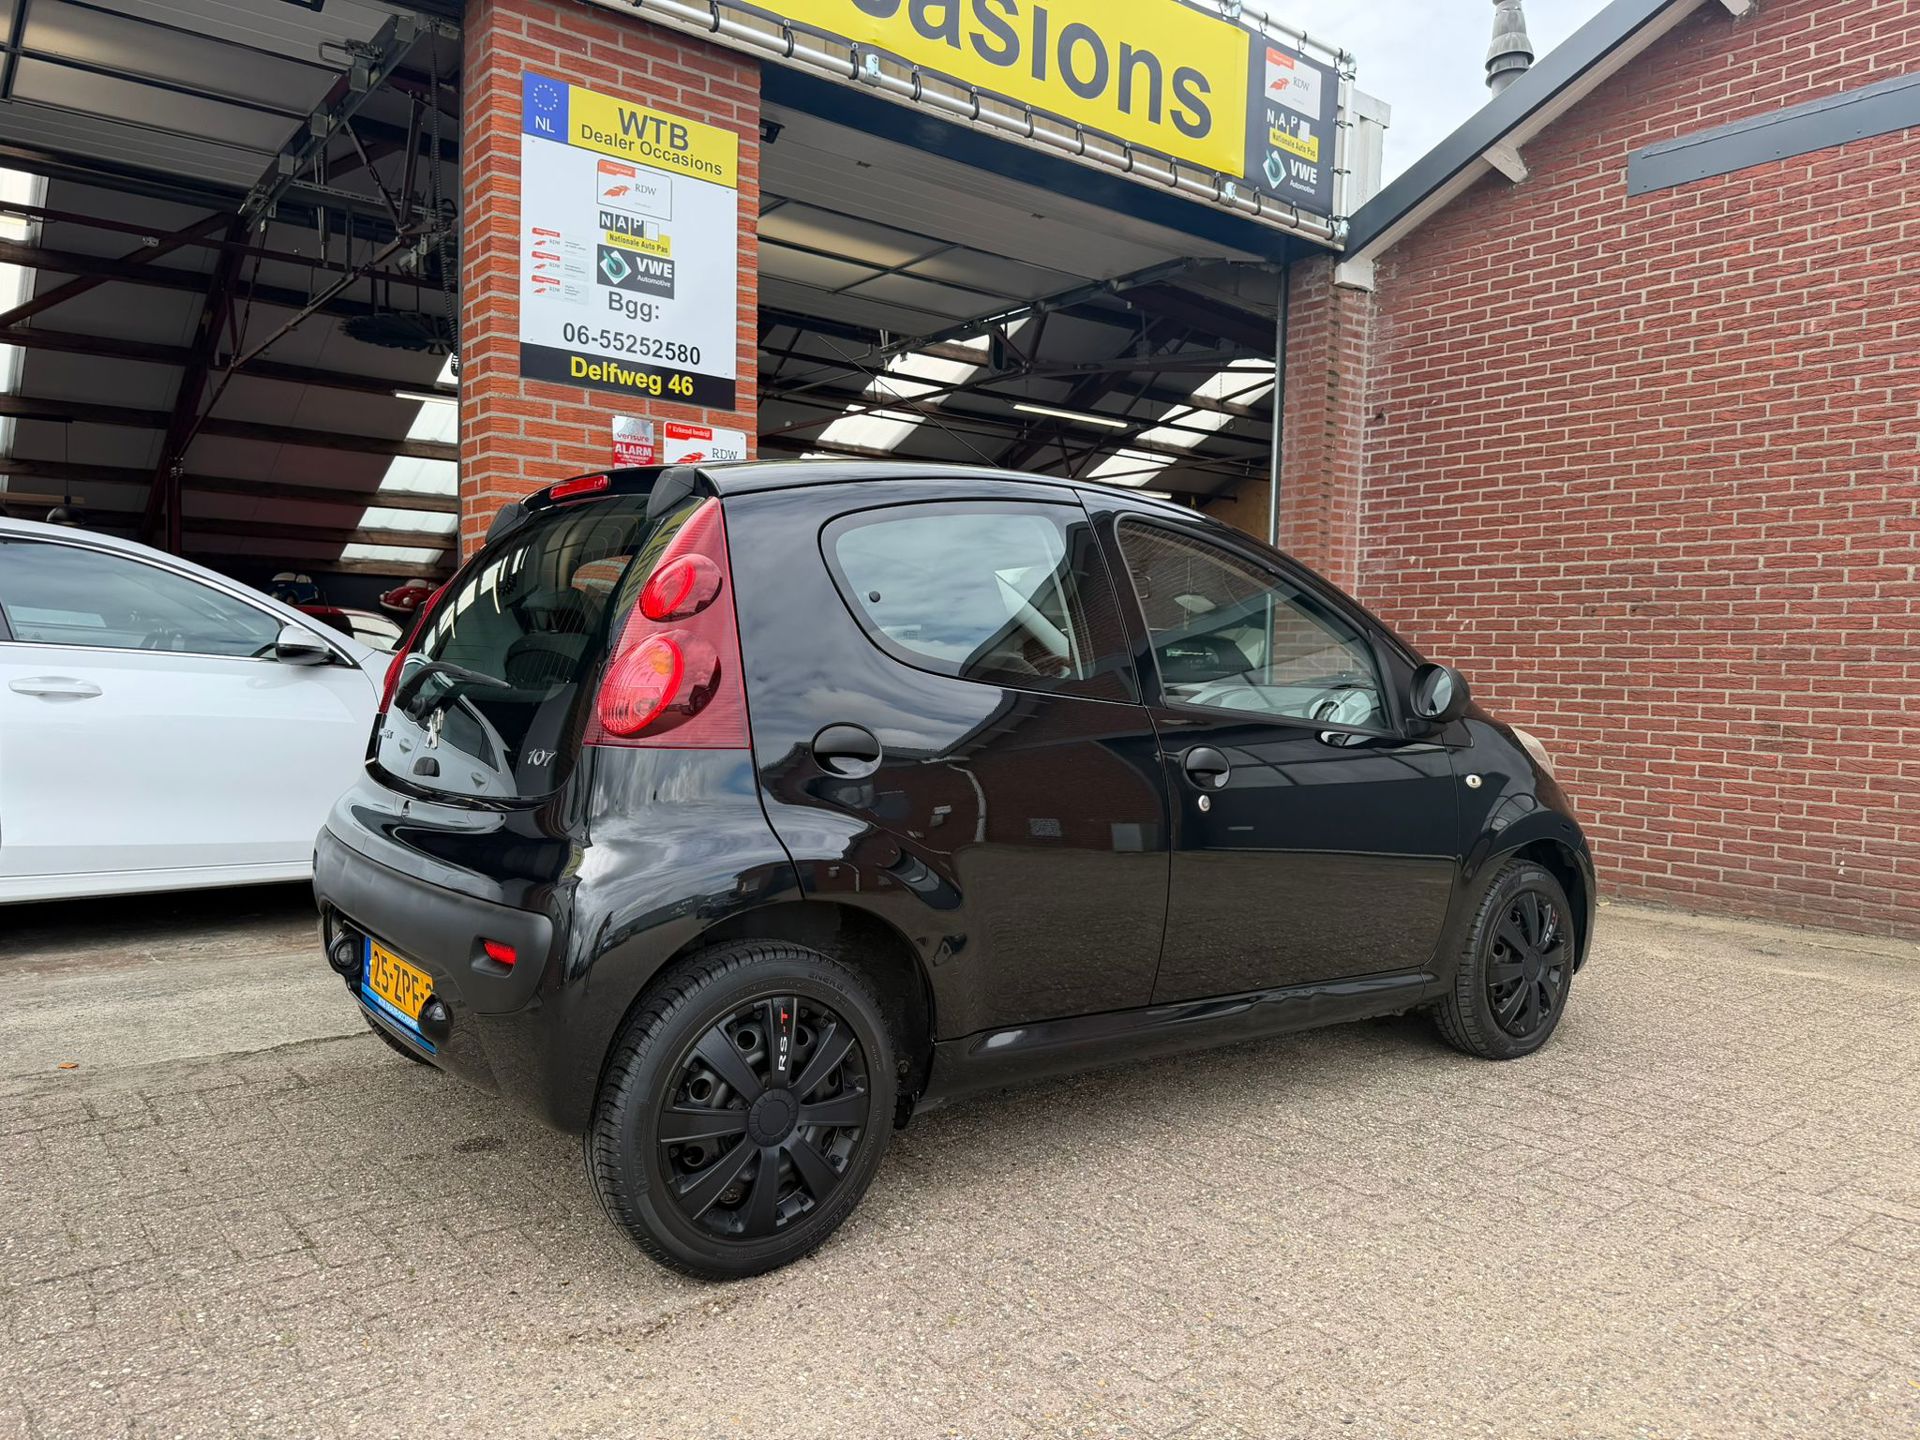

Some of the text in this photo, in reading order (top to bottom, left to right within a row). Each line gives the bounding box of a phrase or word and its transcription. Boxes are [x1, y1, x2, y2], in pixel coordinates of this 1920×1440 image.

[850, 0, 1212, 139] asions
[535, 107, 689, 151] NL WTB
[581, 123, 722, 175] Dealer Occasions
[1290, 159, 1317, 185] VWE
[635, 183, 657, 196] RDW
[1290, 179, 1316, 195] Automotive
[601, 213, 642, 229] NAP
[609, 233, 668, 254] Nationale Auto Pas
[636, 256, 673, 278] VWE
[637, 275, 671, 288] Automotive
[608, 290, 660, 322] Bgg:
[563, 322, 701, 365] 06-55252580
[570, 355, 694, 396] Delfweg 46
[615, 443, 652, 457] ALARM
[712, 447, 738, 460] RDW
[527, 748, 556, 767] 107
